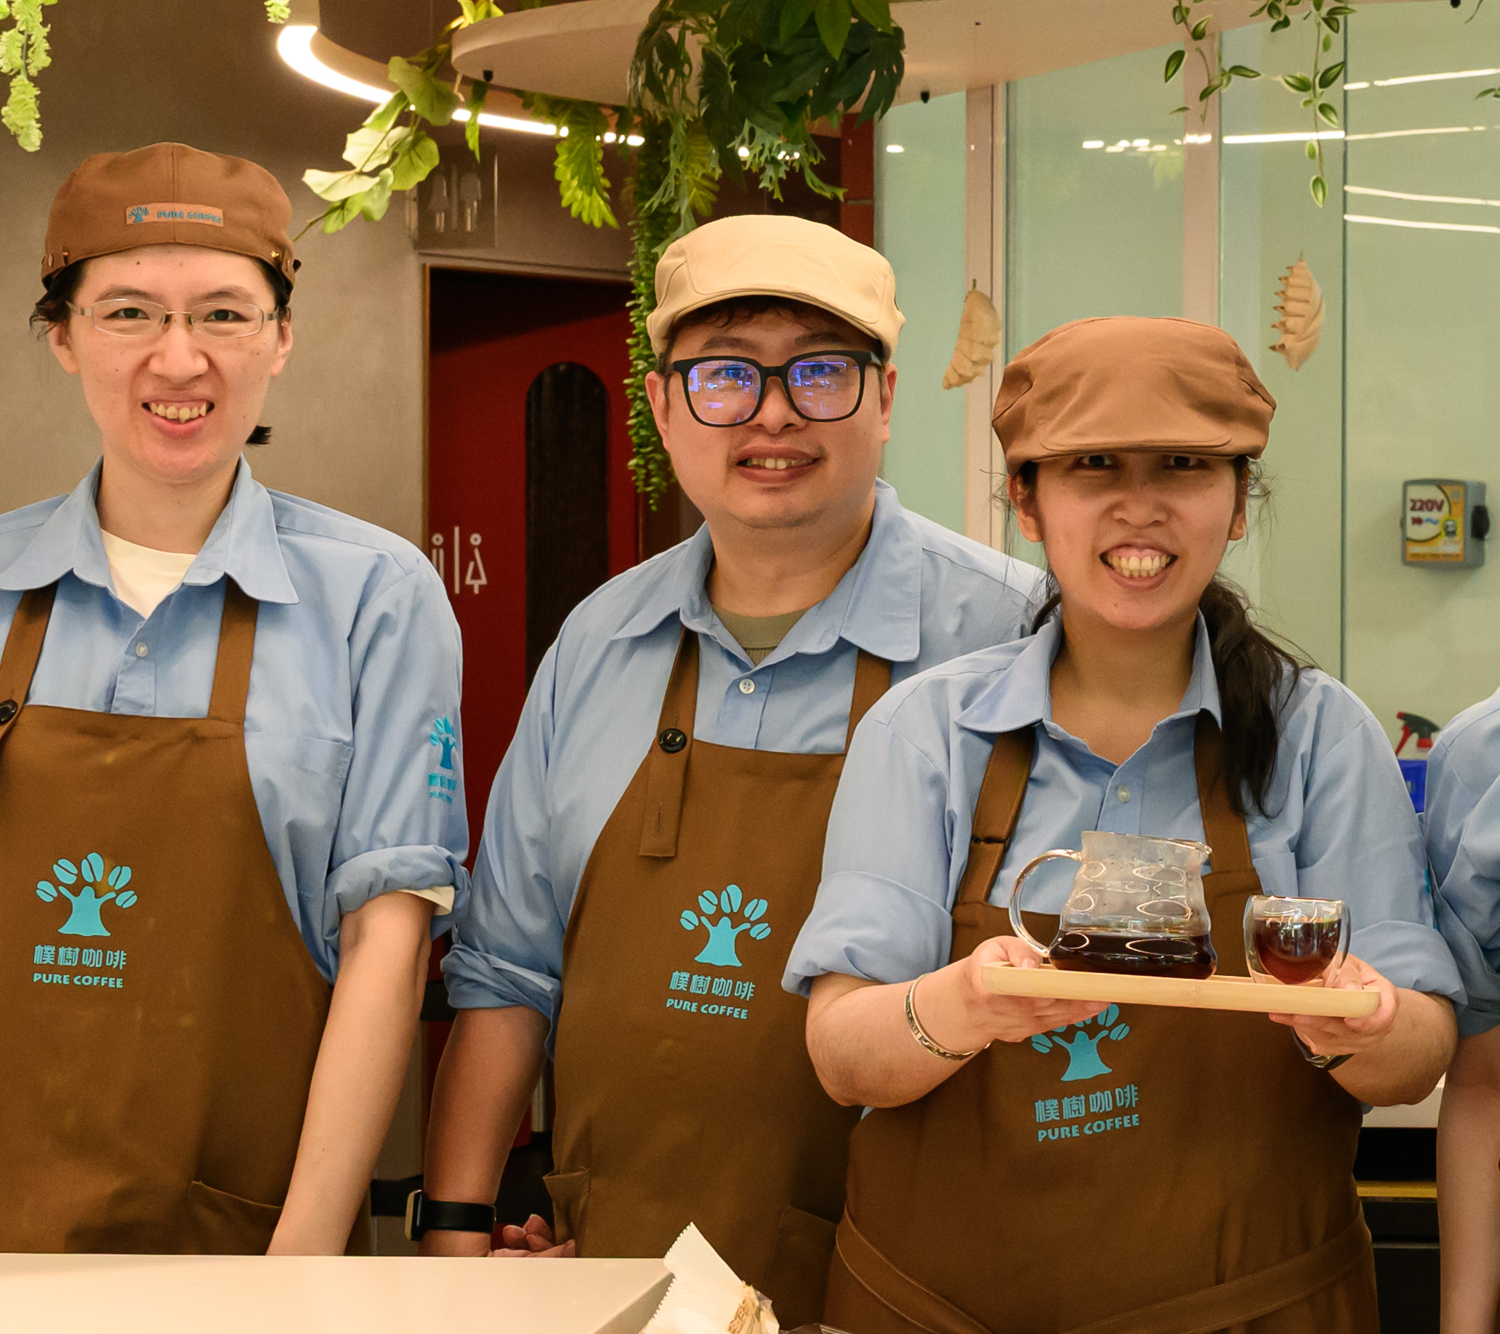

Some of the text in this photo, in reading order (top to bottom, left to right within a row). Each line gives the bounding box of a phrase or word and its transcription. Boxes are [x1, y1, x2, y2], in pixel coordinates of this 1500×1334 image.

[1409, 498, 1445, 513] 220V
[33, 972, 124, 989] PURE COFFEE
[665, 998, 749, 1020] PURE COFFEE
[1037, 1113, 1141, 1143] PURE COFFEE
